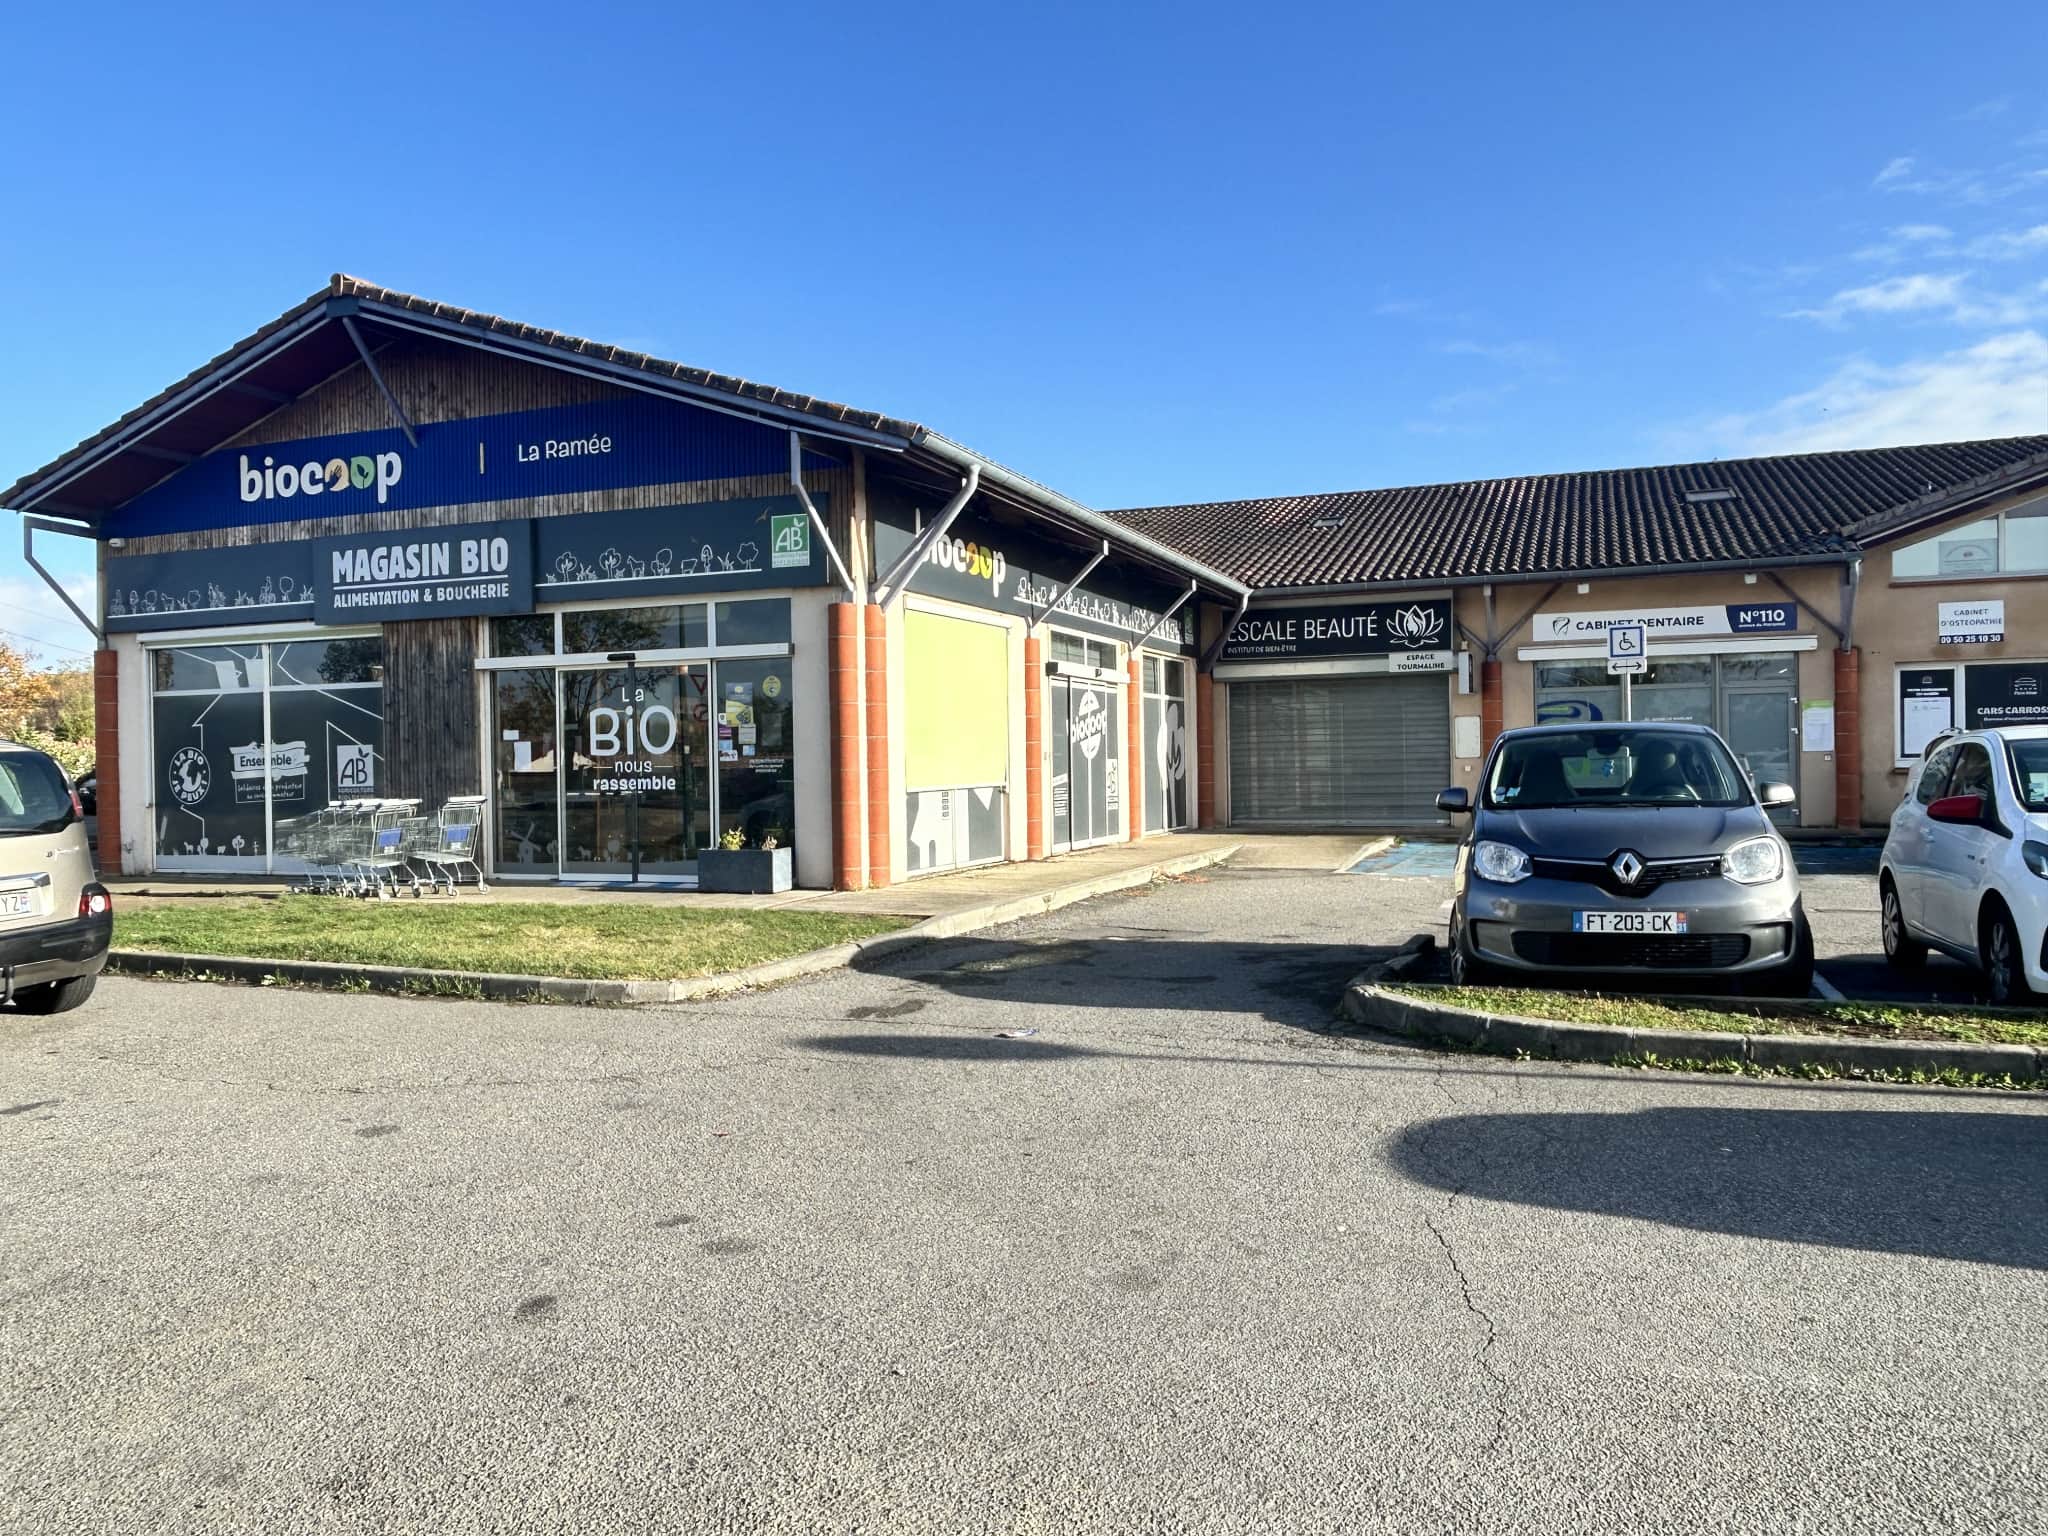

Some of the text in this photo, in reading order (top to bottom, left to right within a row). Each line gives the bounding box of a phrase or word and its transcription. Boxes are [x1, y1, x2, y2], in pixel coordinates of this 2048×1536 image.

[518, 433, 612, 462] La Ramée
[239, 452, 402, 504] biocoop
[775, 527, 803, 552] AB
[332, 537, 509, 584] MAGASIN BIO
[333, 582, 509, 609] ALIMENTATION & BOUCHERIE
[1739, 609, 1785, 624] N°110
[1953, 608, 1990, 616] CABINET
[1303, 611, 1378, 640] BEAUTÉ
[1965, 635, 1976, 643] 25
[1978, 634, 1989, 642] 10
[621, 686, 645, 702] La
[1977, 706, 2004, 715] CARS
[340, 758, 369, 786] AB
[614, 760, 653, 773] nous
[593, 775, 676, 791] rassemble
[1586, 914, 1673, 931] FT-203-CK
